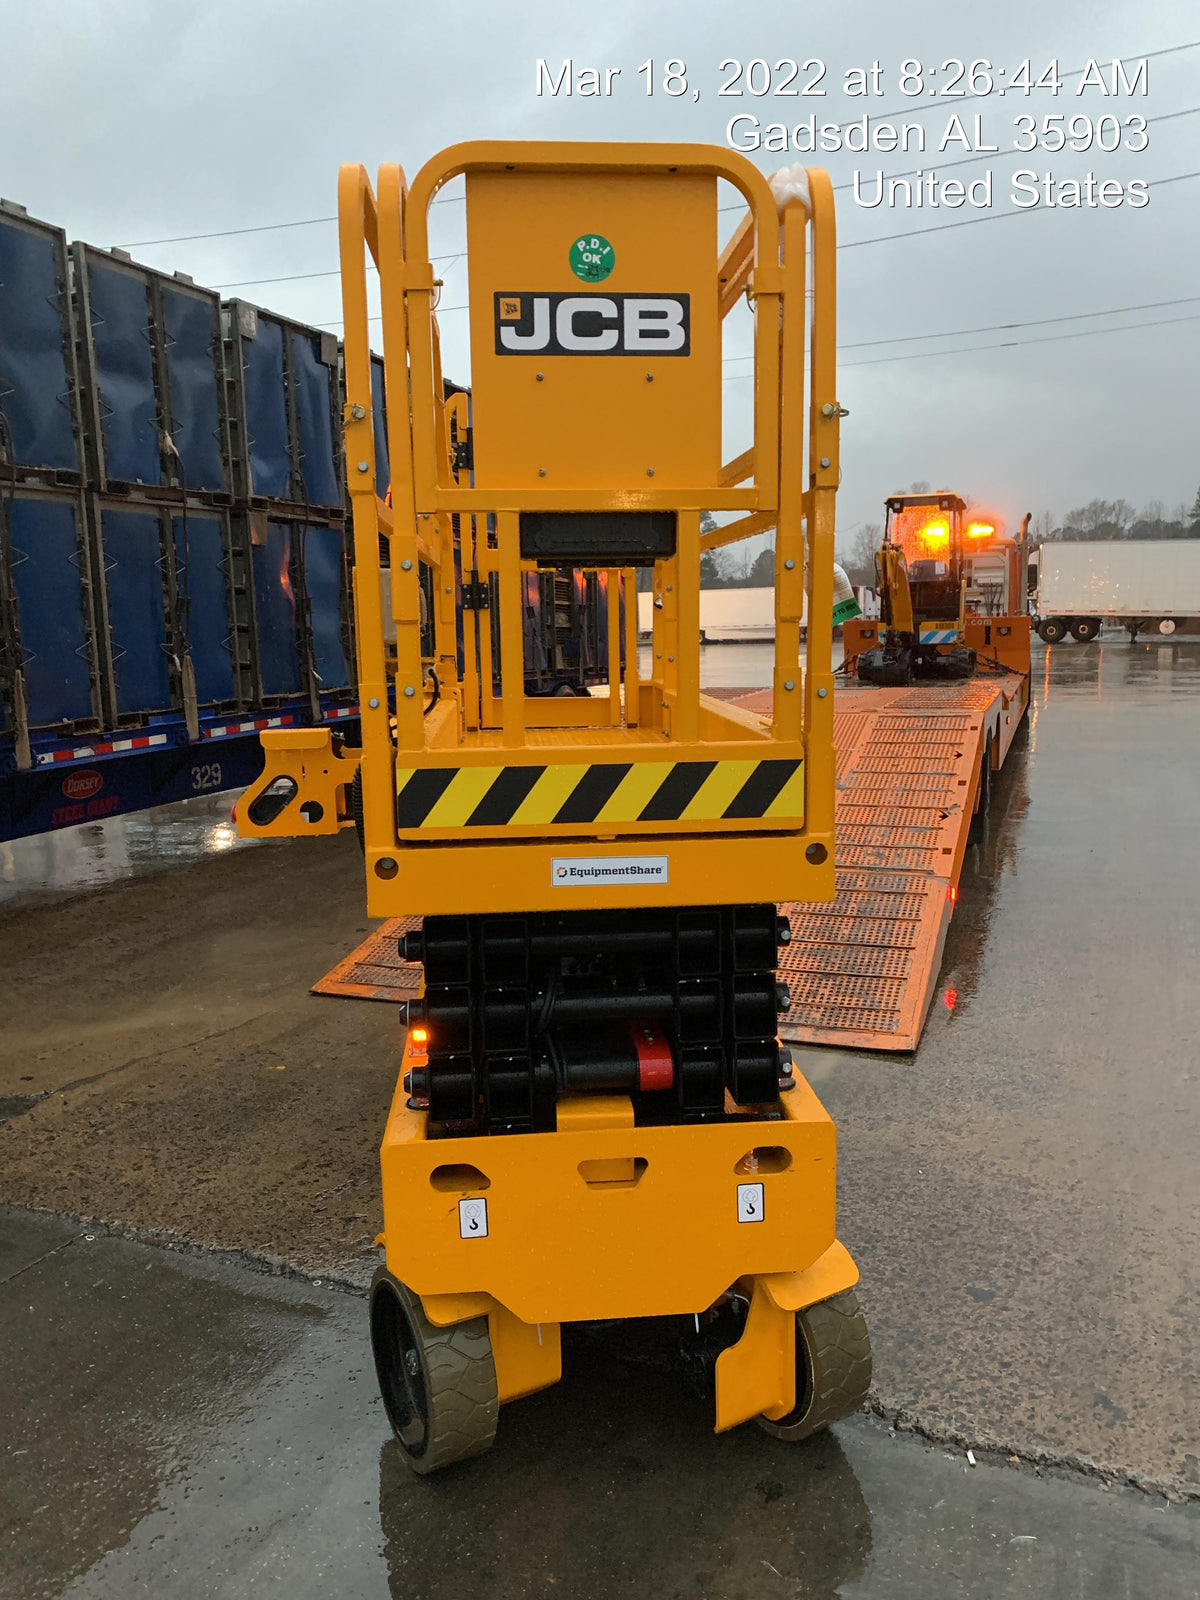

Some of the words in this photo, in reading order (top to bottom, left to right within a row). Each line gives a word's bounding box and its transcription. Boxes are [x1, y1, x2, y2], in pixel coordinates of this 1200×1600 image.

[582, 252, 602, 264] OK
[500, 297, 686, 350] JCB
[191, 762, 222, 790] 329
[67, 777, 100, 793] DORSEY
[569, 865, 663, 878] EquipmentShare
